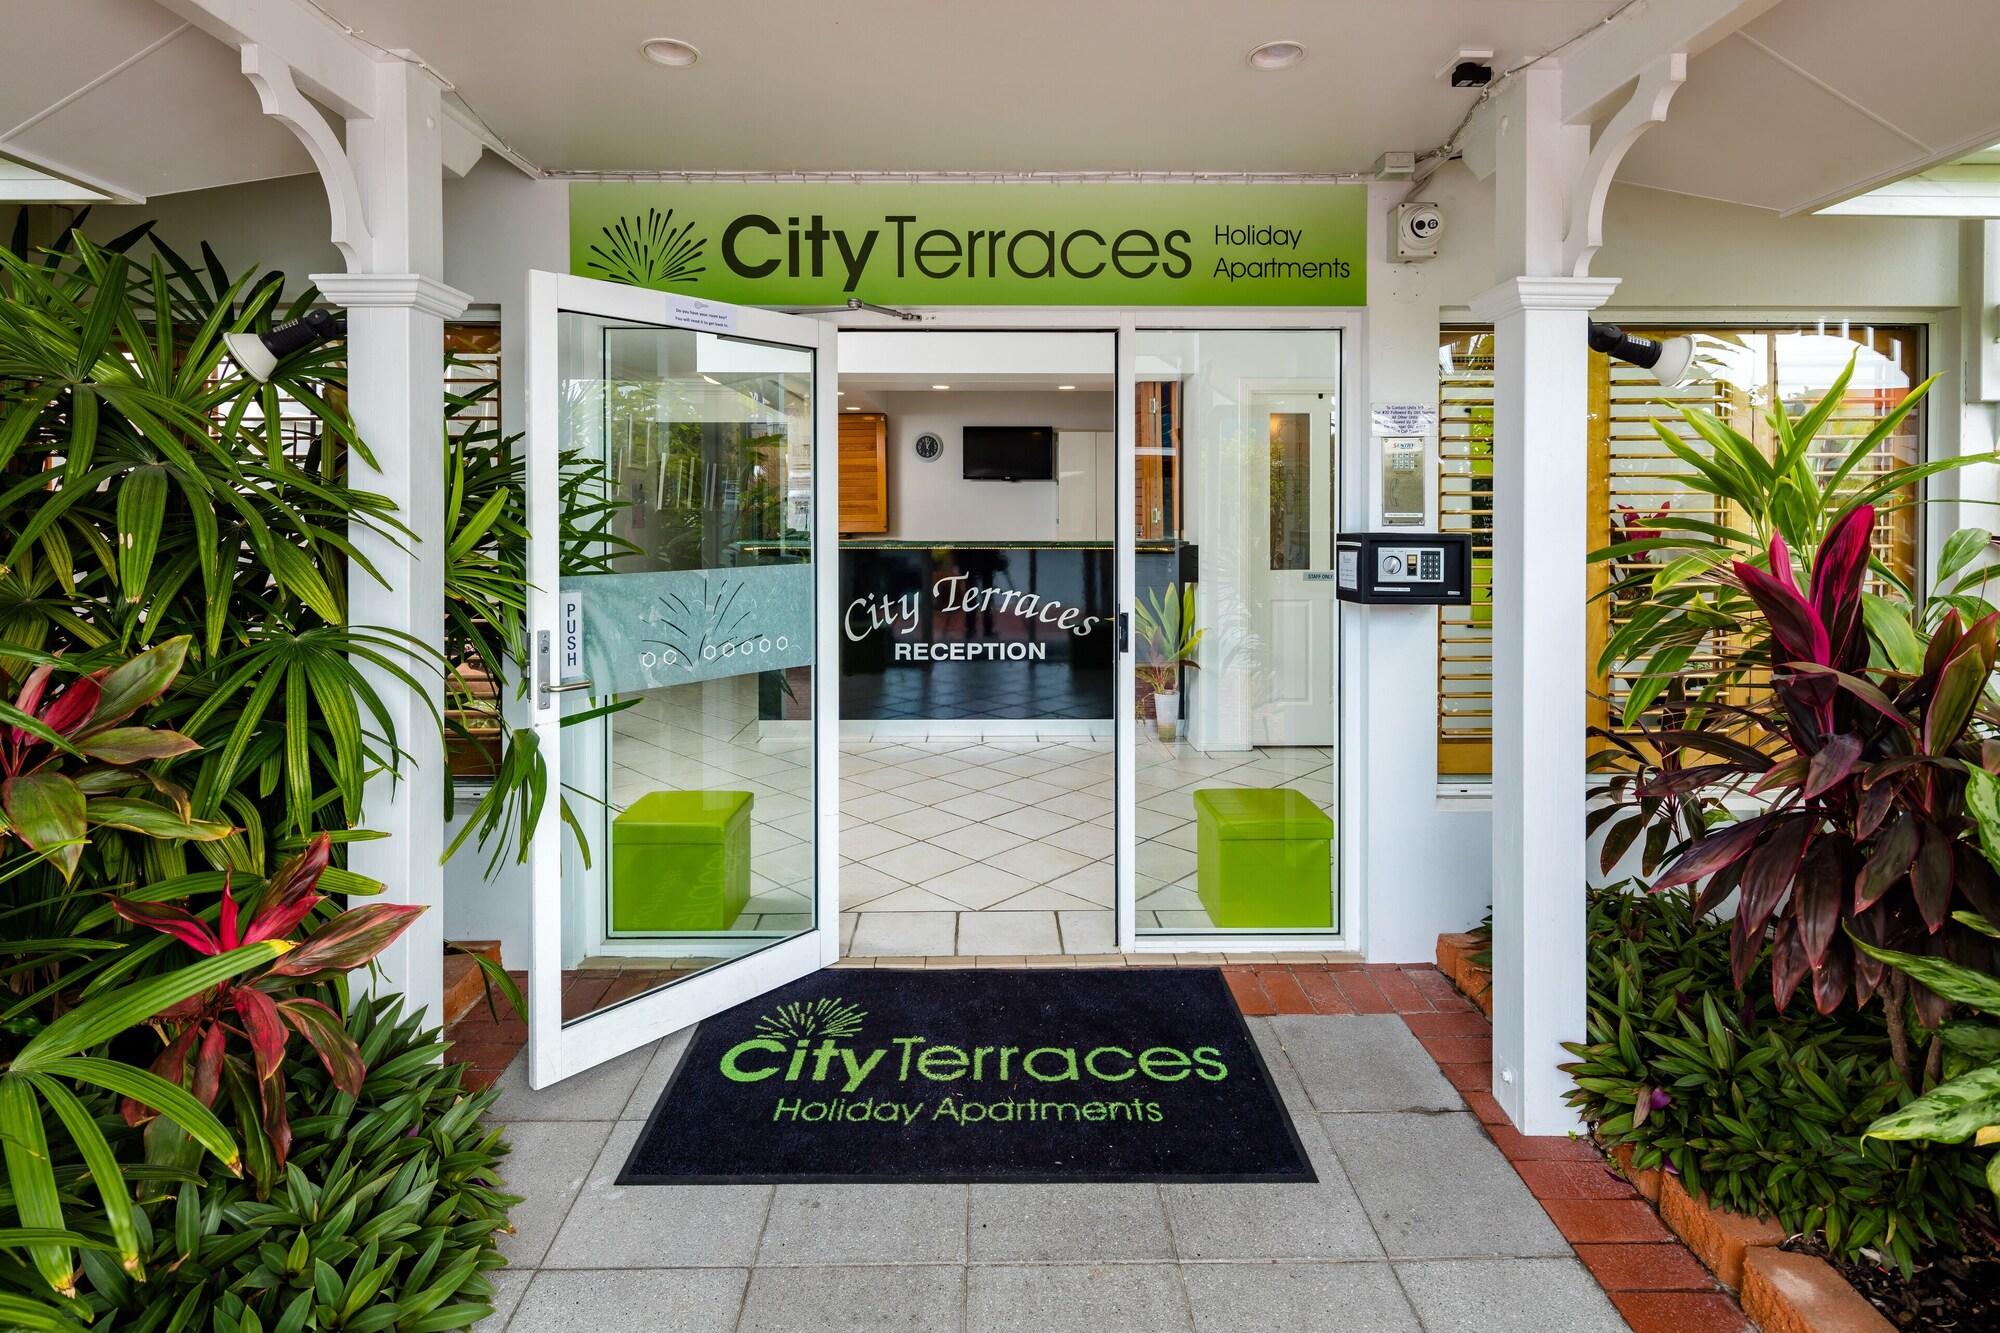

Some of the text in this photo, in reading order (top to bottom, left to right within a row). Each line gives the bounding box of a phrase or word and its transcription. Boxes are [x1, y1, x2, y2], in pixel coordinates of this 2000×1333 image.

[1215, 225, 1302, 250] Holiday
[1213, 257, 1351, 282] Apartments
[844, 571, 1100, 642] City Terraces
[567, 603, 577, 666] PUSH
[894, 642, 1046, 661] RECEPTION
[772, 1097, 1164, 1126] Holiday Apartments
